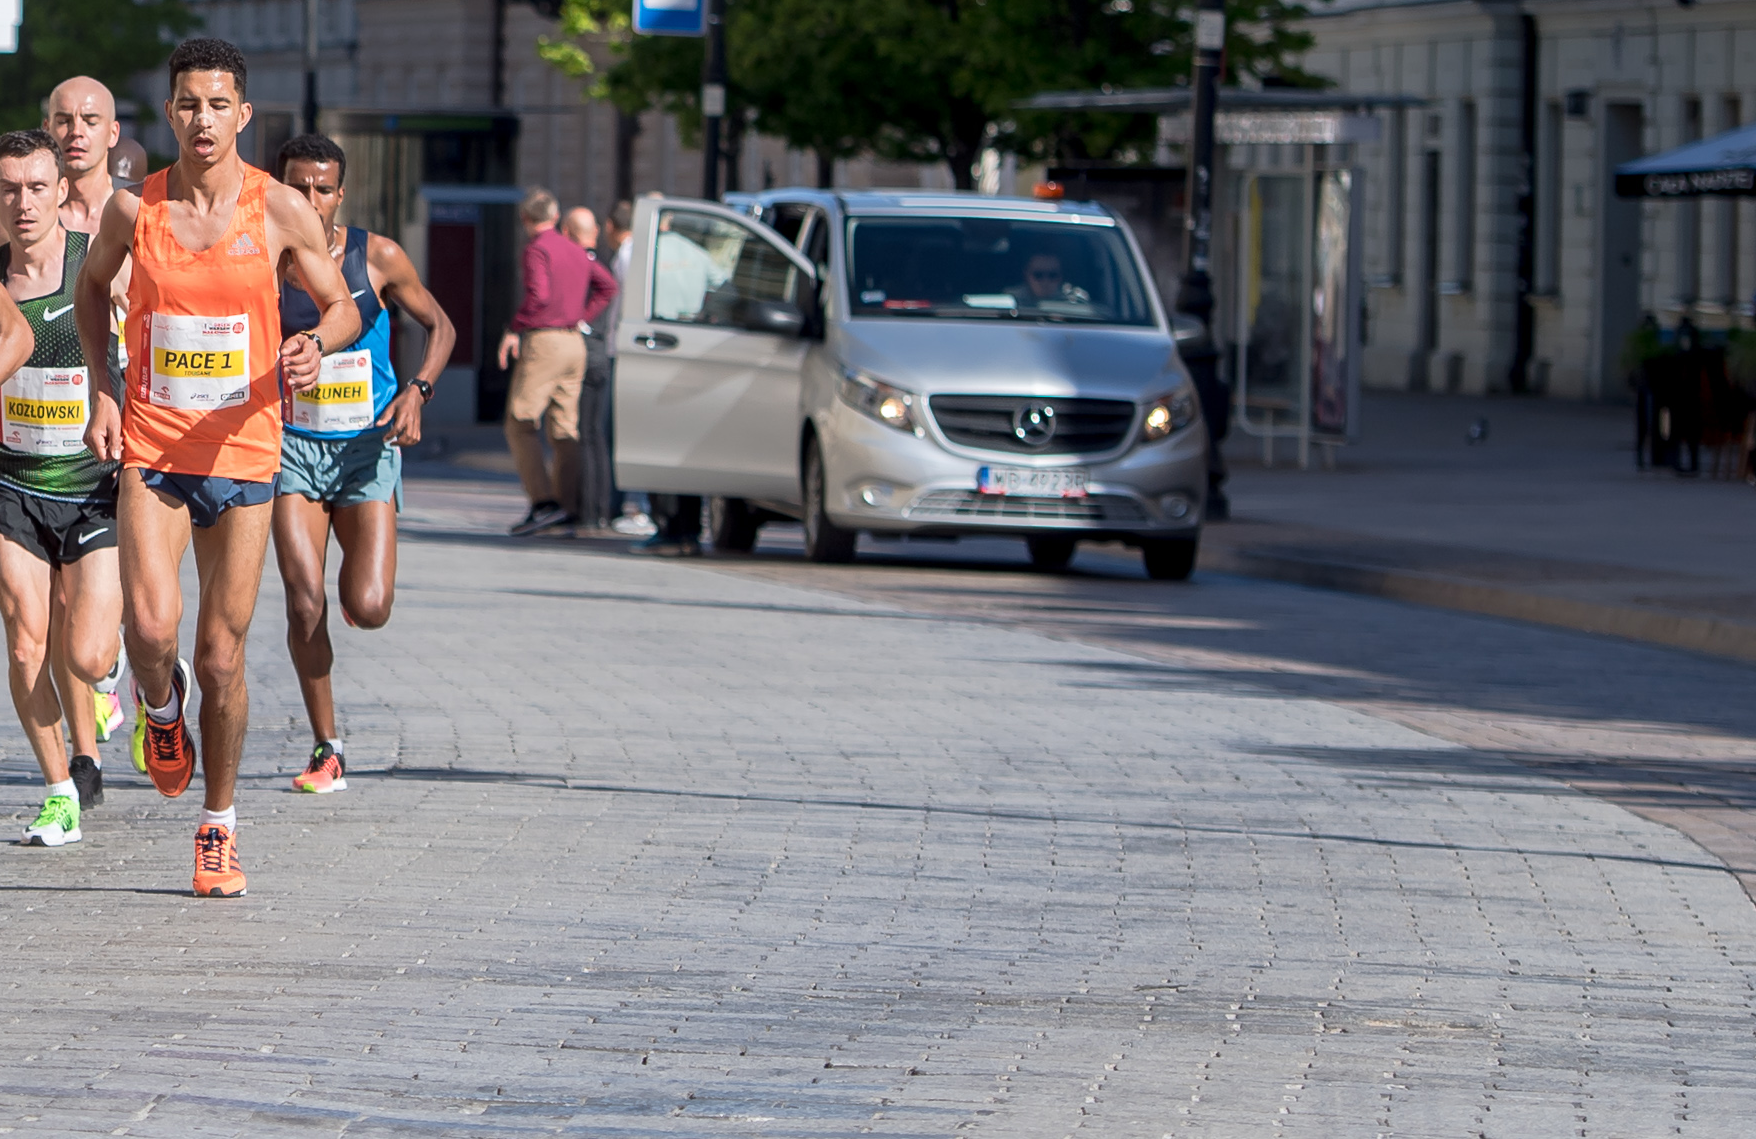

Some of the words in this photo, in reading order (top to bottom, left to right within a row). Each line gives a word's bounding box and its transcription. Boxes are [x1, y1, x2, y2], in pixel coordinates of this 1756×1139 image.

[165, 351, 215, 369] PACE
[221, 353, 232, 369] 1
[9, 402, 80, 418] KOZŁOWSKI
